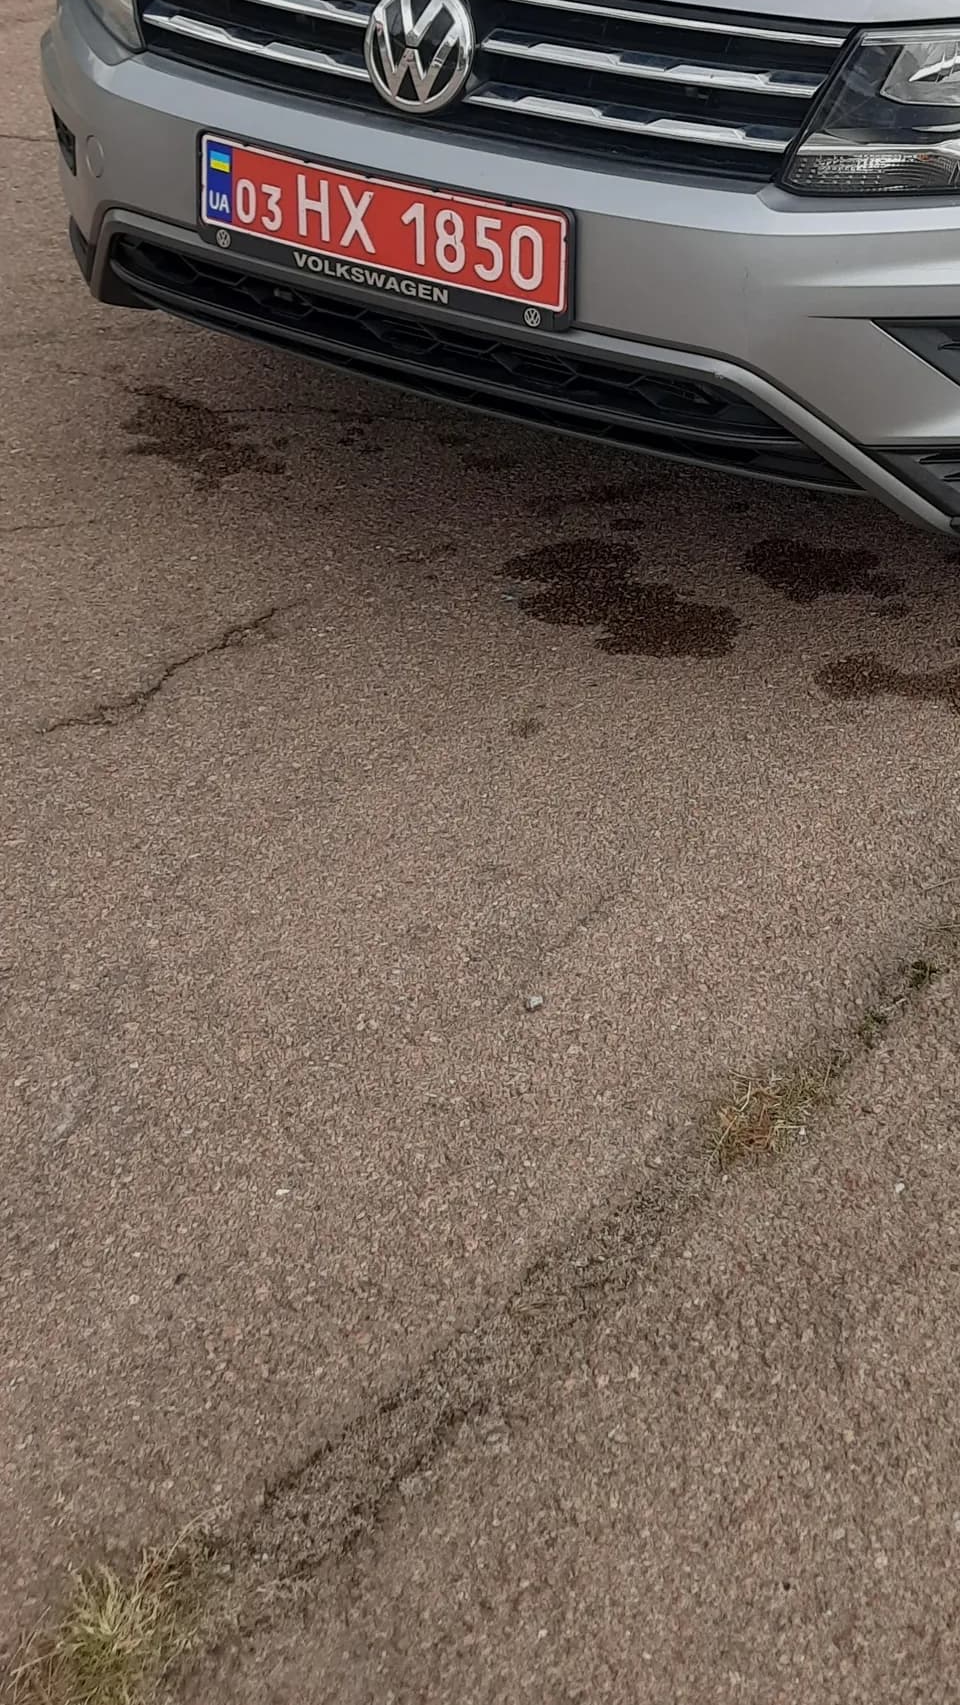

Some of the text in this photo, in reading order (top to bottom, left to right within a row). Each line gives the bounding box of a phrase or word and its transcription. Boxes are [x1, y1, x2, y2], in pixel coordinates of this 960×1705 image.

[208, 193, 230, 214] UA
[235, 173, 544, 291] 03 HX 1850
[293, 251, 449, 305] VOLKSWAGEN
